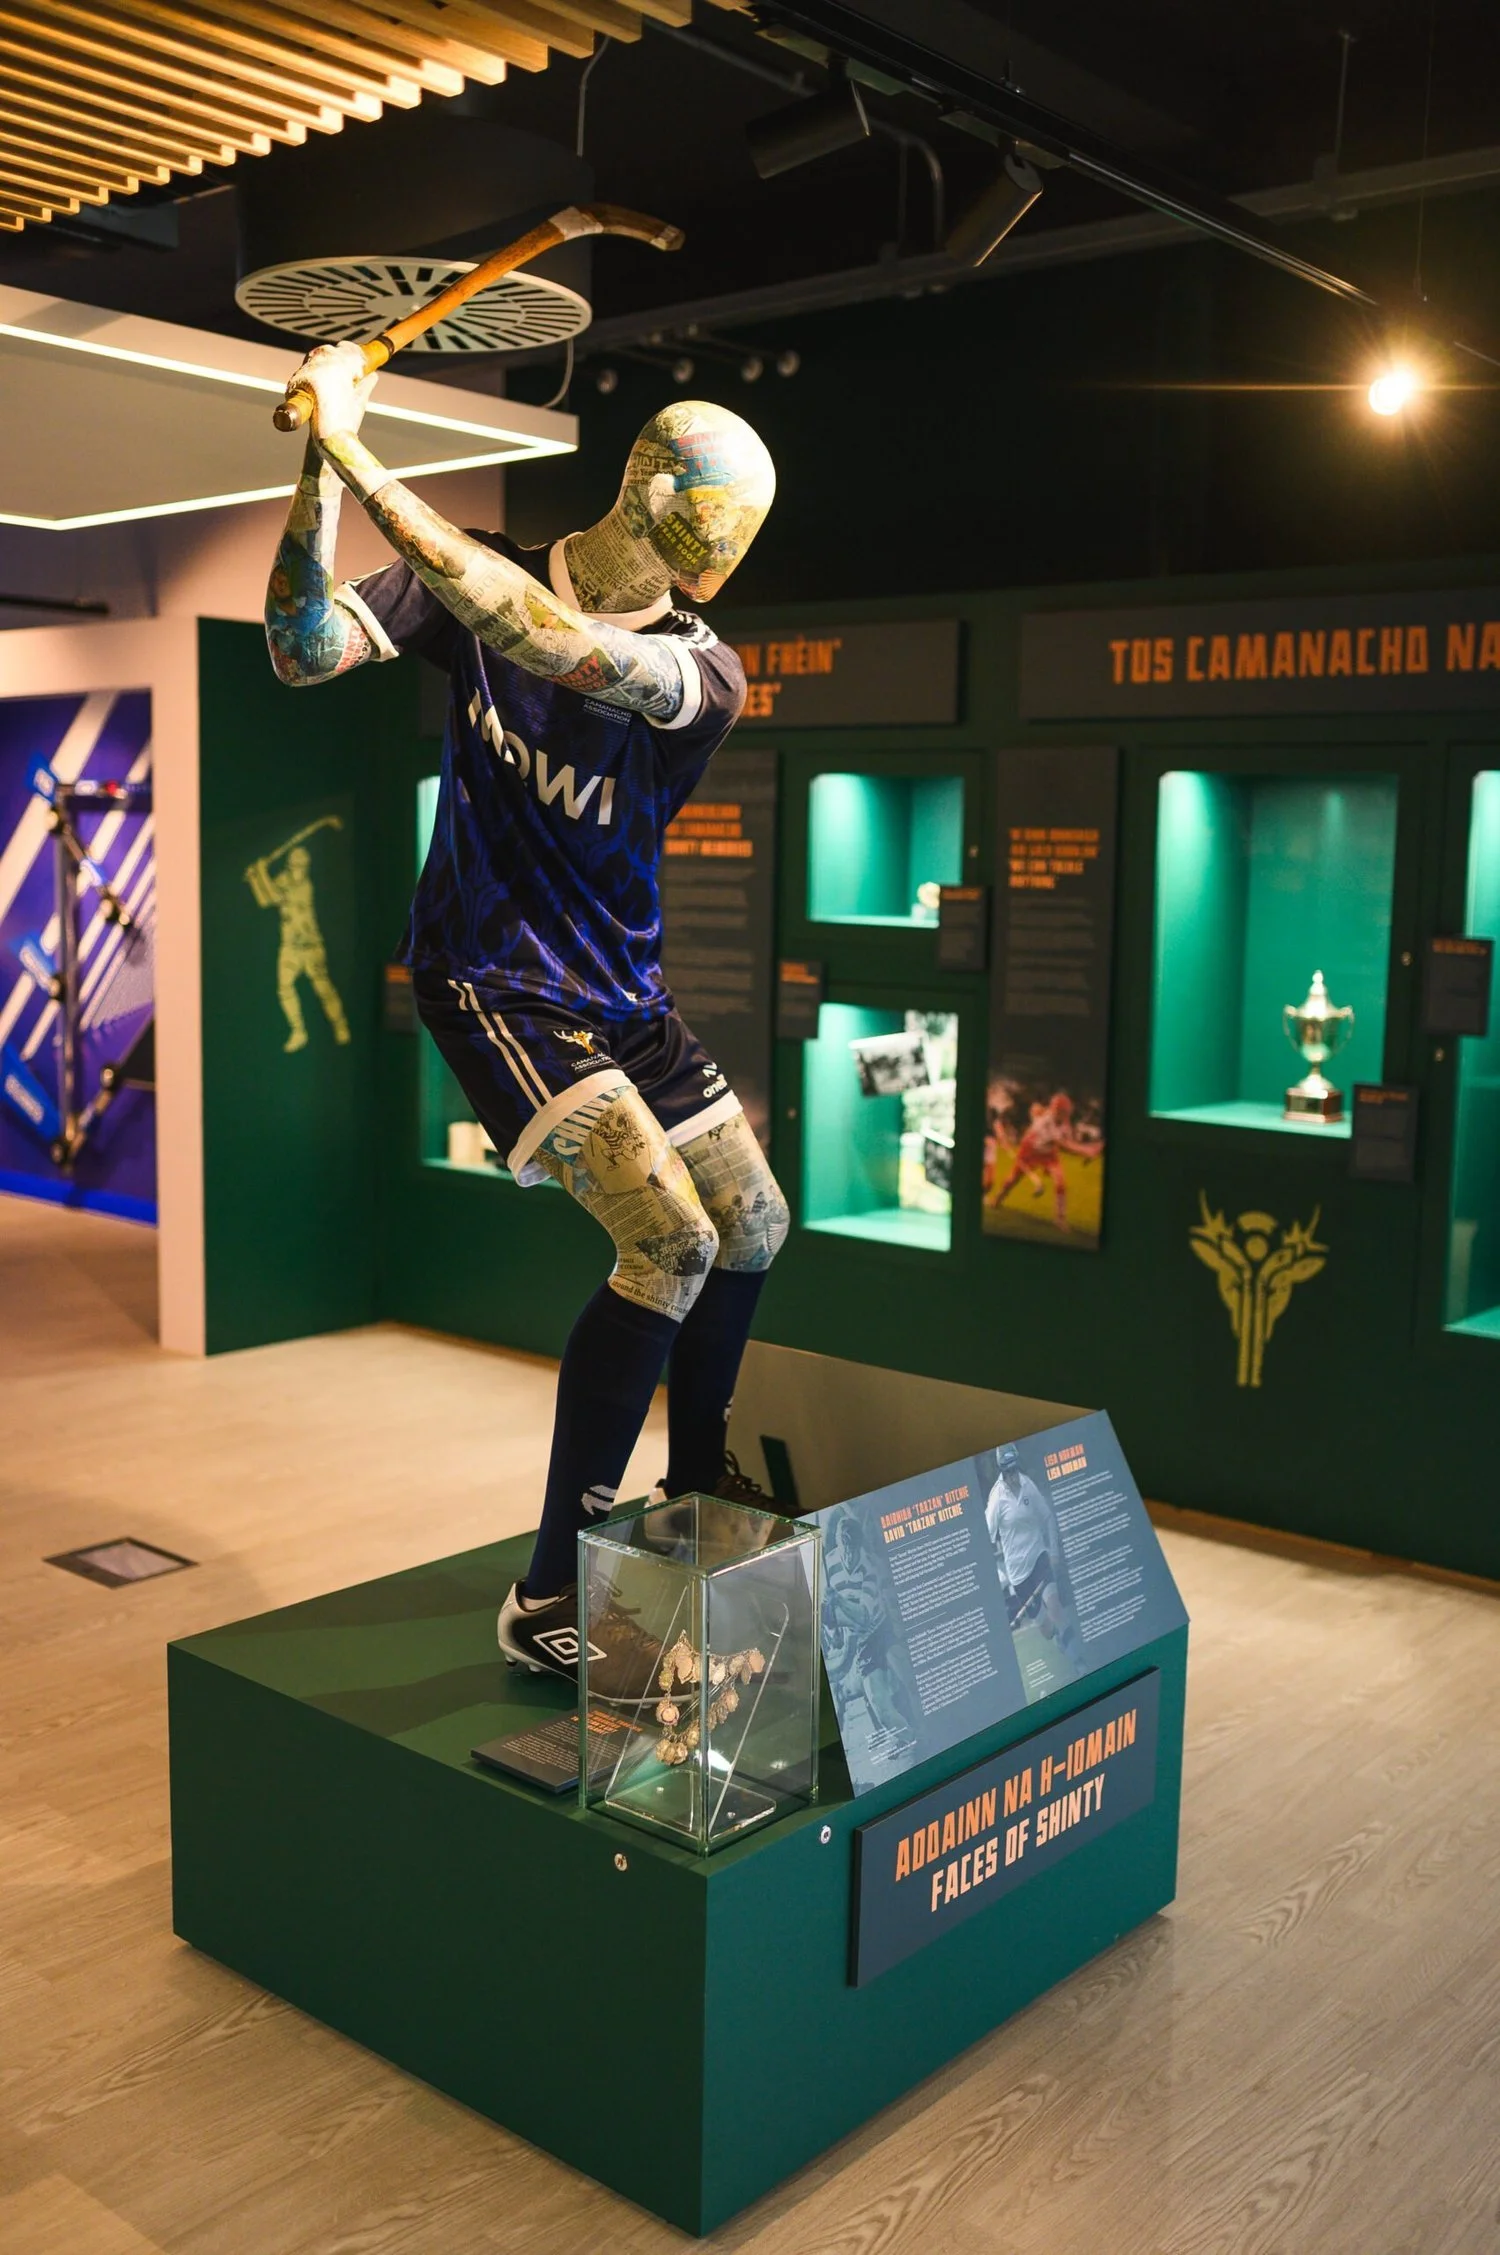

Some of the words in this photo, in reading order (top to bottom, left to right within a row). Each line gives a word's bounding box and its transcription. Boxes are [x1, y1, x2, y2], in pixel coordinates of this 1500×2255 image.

[665, 513, 709, 557] SHINTY
[676, 543, 698, 565] BOOK
[1109, 637, 1174, 684] TOS
[1186, 624, 1429, 681] CAMANACHD
[1446, 620, 1500, 671] NA
[583, 704, 631, 723] ASSOCIATION
[634, 1287, 646, 1298] the
[646, 1293, 670, 1309] shinty
[883, 1526, 905, 1544] DAVID
[896, 1787, 996, 1882] AODAINN
[1003, 1767, 1032, 1818] NA
[1040, 1708, 1137, 1796] H-IOMAIN
[931, 1837, 998, 1912] FACES
[1004, 1818, 1030, 1866] OF
[1036, 1773, 1105, 1847] SHINTY
